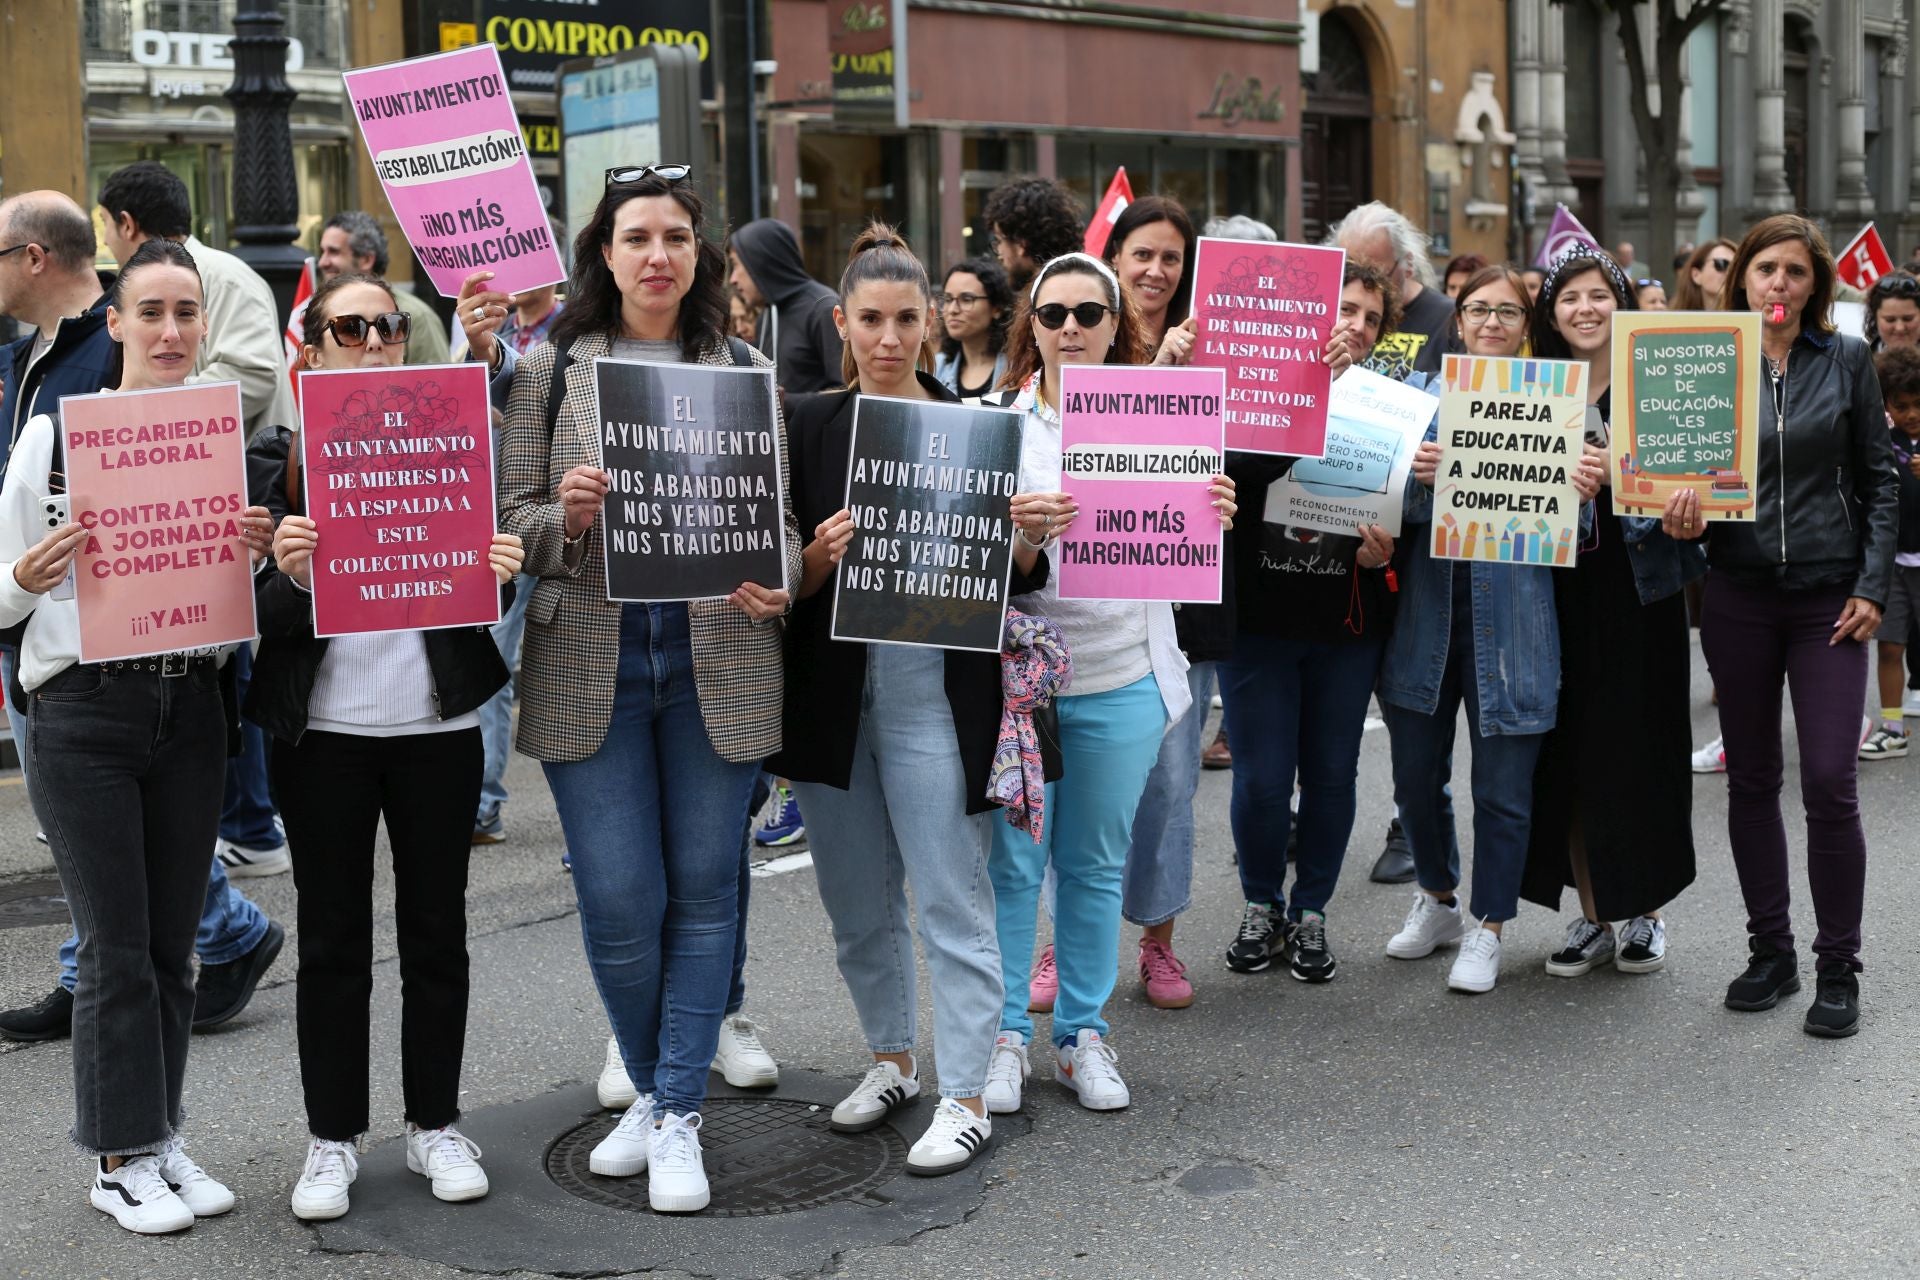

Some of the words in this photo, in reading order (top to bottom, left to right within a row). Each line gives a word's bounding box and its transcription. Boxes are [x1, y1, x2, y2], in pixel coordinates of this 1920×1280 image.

[485, 15, 634, 56] COMPRO
[357, 74, 502, 121] ¡AYUNTAMIENTO!
[376, 136, 524, 180] ¡¡ESTABILIZACIÓN!!
[420, 211, 456, 238] ¡¡NO
[458, 198, 504, 233] MÁS
[414, 226, 550, 269] MARGINACIÓN!!
[1258, 276, 1276, 290] EL
[1204, 293, 1327, 316] AYUNTAMIENTO
[1208, 319, 1230, 332] DE
[1232, 320, 1292, 338] MIERES
[1295, 326, 1318, 340] DA
[1205, 341, 1226, 355] LA
[1229, 342, 1302, 362] ESPALDA
[1634, 347, 1648, 362] SI
[1654, 344, 1736, 360] NOSOTRAS
[1238, 367, 1278, 382] ESTE
[1645, 364, 1667, 377] NO
[1674, 362, 1726, 377] SOMOS
[1676, 380, 1696, 393] DE
[672, 396, 697, 422] EL
[1066, 392, 1220, 416] ¡AYUNTAMIENTO!
[1293, 394, 1315, 408] DE
[1470, 400, 1552, 422] PAREJA
[1640, 395, 1734, 412] EDUCACIÓN,
[384, 412, 407, 427] EL
[69, 416, 236, 450] PRECARIEDAD
[605, 422, 772, 456] AYUNTAMIENTO
[1343, 434, 1390, 451] QUIERES
[1452, 430, 1566, 454] EDUCATIVA
[101, 442, 212, 470] LABORAL
[320, 435, 475, 458] AYUNTAMIENTO
[927, 432, 949, 460] EL
[1354, 449, 1390, 464] SOMOS
[1644, 450, 1686, 466] ¿QUÉ
[1694, 449, 1733, 463] SON?
[1062, 450, 1222, 474] ¡¡ESTABILIZACIÓN!!
[1357, 462, 1364, 472] B
[1448, 460, 1462, 478] A
[1471, 461, 1566, 484] JORNADA
[328, 473, 356, 490] DE
[360, 468, 436, 488] MIERES
[441, 466, 470, 484] DA
[606, 468, 644, 495] NOS
[654, 473, 775, 500] ABANDONA,
[854, 458, 1014, 498] AYUNTAMIENTO
[78, 494, 240, 530] CONTRATOS
[329, 501, 356, 518] LA
[360, 496, 454, 516] ESPALDA
[458, 495, 472, 511] A
[624, 500, 662, 526] NOS
[671, 504, 738, 527] VENDE
[747, 504, 758, 525] Y
[1290, 497, 1378, 520] RECONOCIMIENTO
[1452, 490, 1559, 514] COMPLETA
[850, 504, 888, 530] NOS
[896, 508, 1008, 546] ABANDONA,
[1096, 509, 1136, 533] ¡¡NO
[1142, 504, 1185, 534] MÁS
[84, 536, 102, 554] A
[112, 519, 239, 552] JORNADA
[376, 526, 428, 544] ESTE
[613, 529, 651, 555] NOS
[660, 529, 774, 556] TRAICIONA
[92, 544, 235, 579] COMPLETA
[329, 552, 448, 574] COLECTIVO
[452, 550, 478, 566] DE
[862, 536, 900, 562] NOS
[910, 541, 972, 569] VENDE
[980, 548, 991, 570] Y
[1062, 536, 1218, 567] MARGINACIÓN!!
[1300, 554, 1347, 576] Kahlo
[360, 580, 452, 600] MUJERES
[846, 566, 884, 591] NOS
[894, 570, 998, 602] TRAICIONA
[131, 604, 208, 636] ¡¡¡YA!!!
